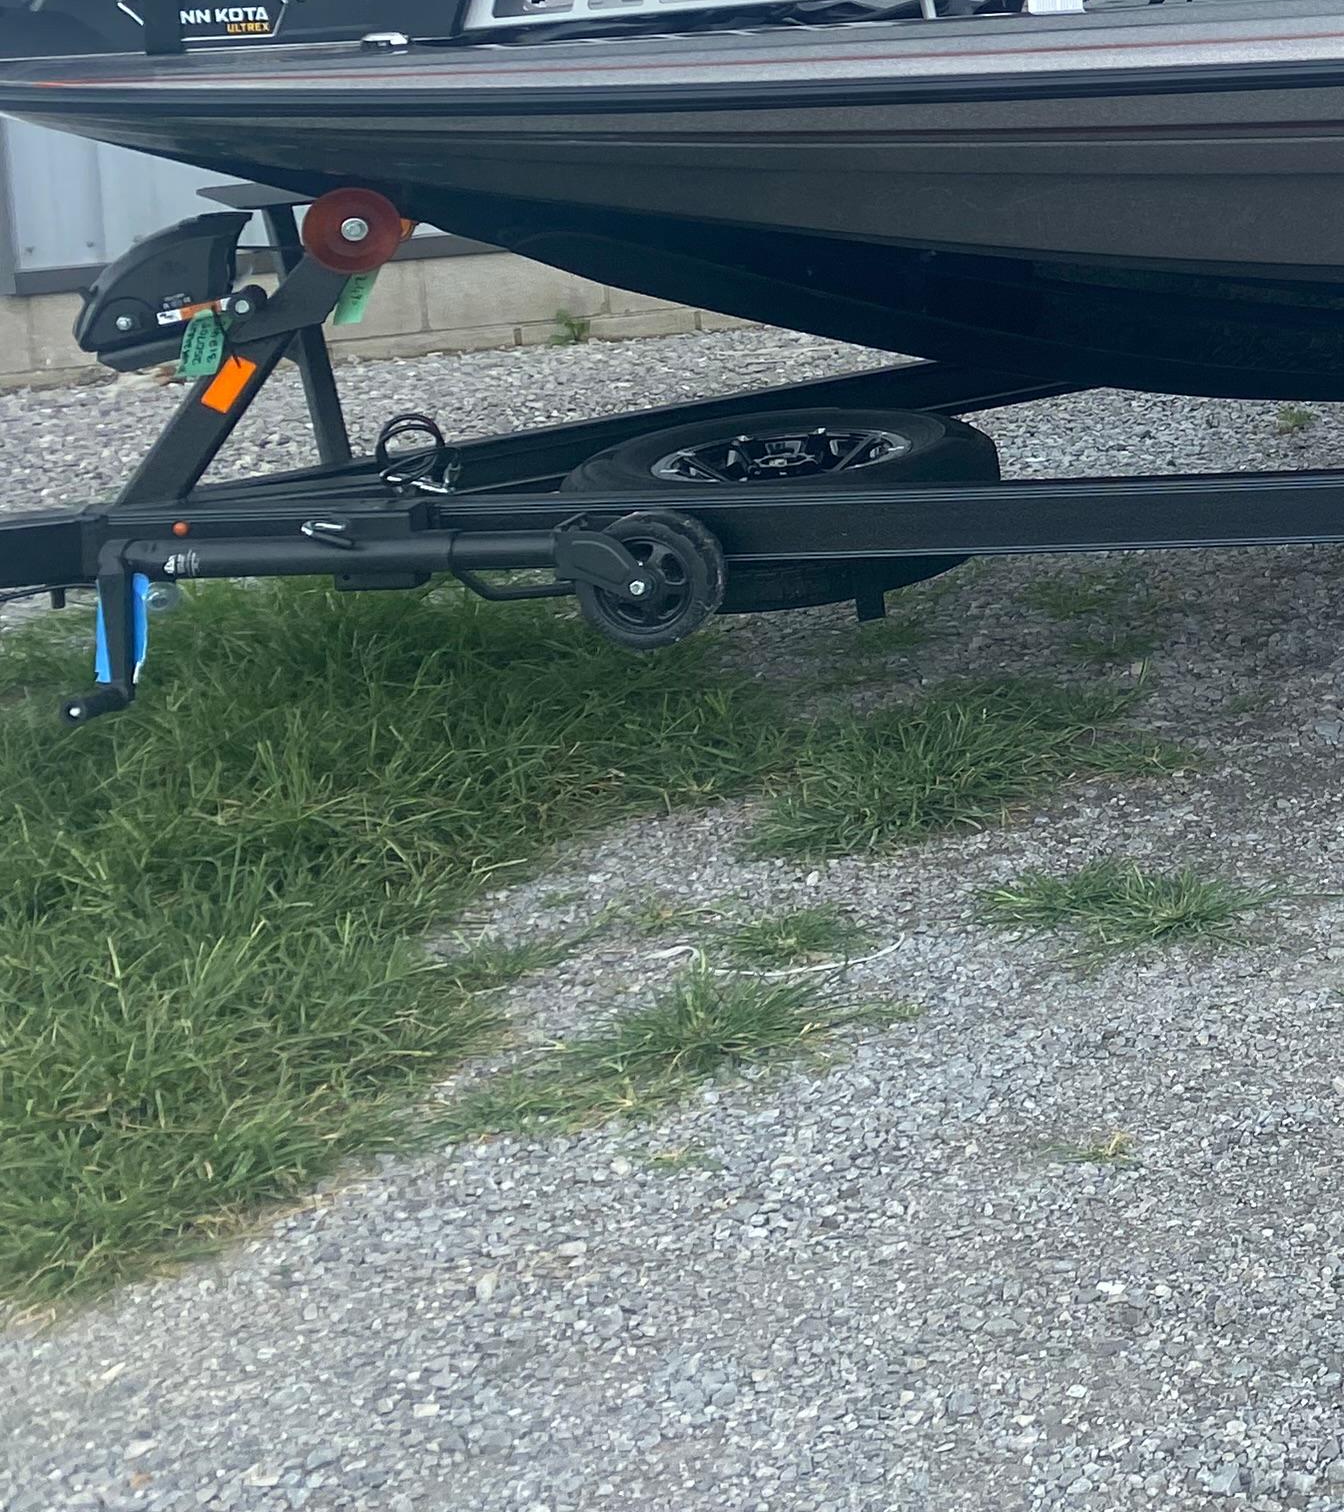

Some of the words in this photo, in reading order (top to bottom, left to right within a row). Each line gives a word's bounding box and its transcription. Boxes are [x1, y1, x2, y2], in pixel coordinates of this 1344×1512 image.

[180, 9, 212, 25] NN
[215, 6, 269, 23] KOTA
[226, 22, 270, 33] ULTREX
